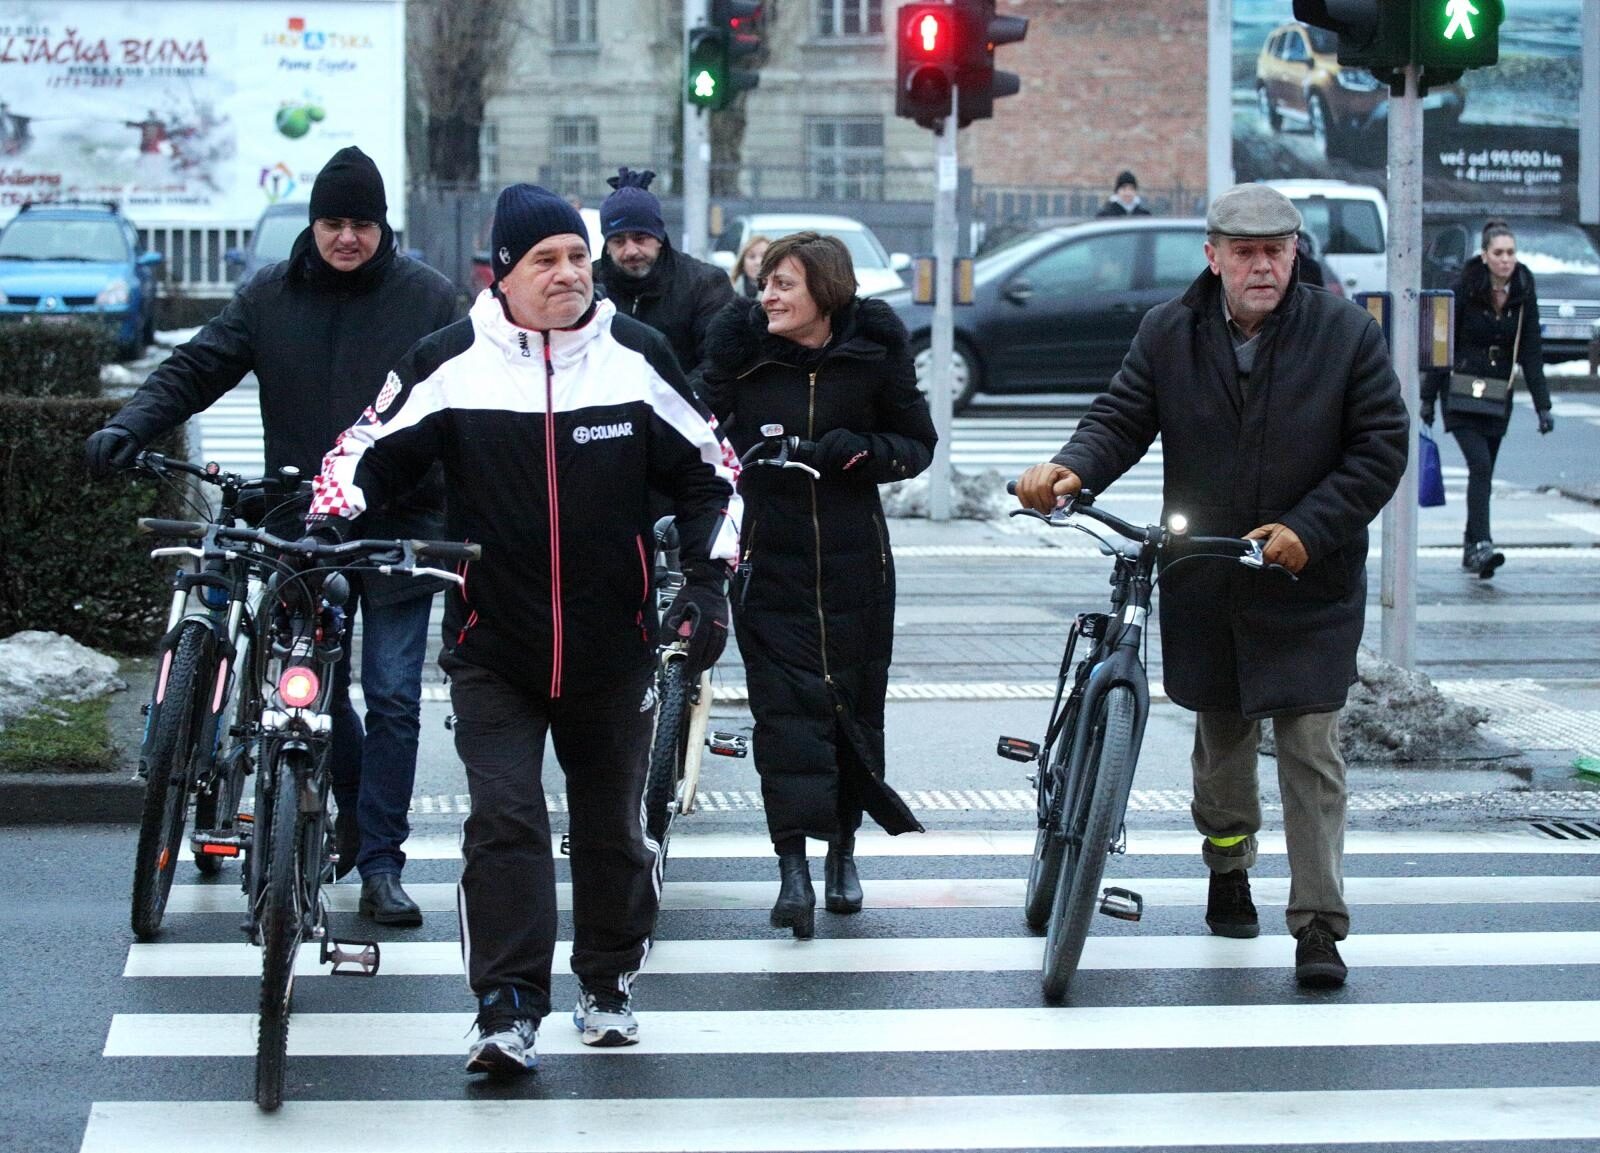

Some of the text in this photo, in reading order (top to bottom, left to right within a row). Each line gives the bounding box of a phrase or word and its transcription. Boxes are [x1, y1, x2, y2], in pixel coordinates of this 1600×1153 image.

[120, 37, 208, 64] BUNA
[1468, 149, 1489, 167] od
[1543, 150, 1563, 167] kn
[1466, 166, 1477, 181] 4
[1478, 168, 1521, 182] zimske
[1523, 170, 1561, 185] gume
[590, 421, 634, 440] COLMAR
